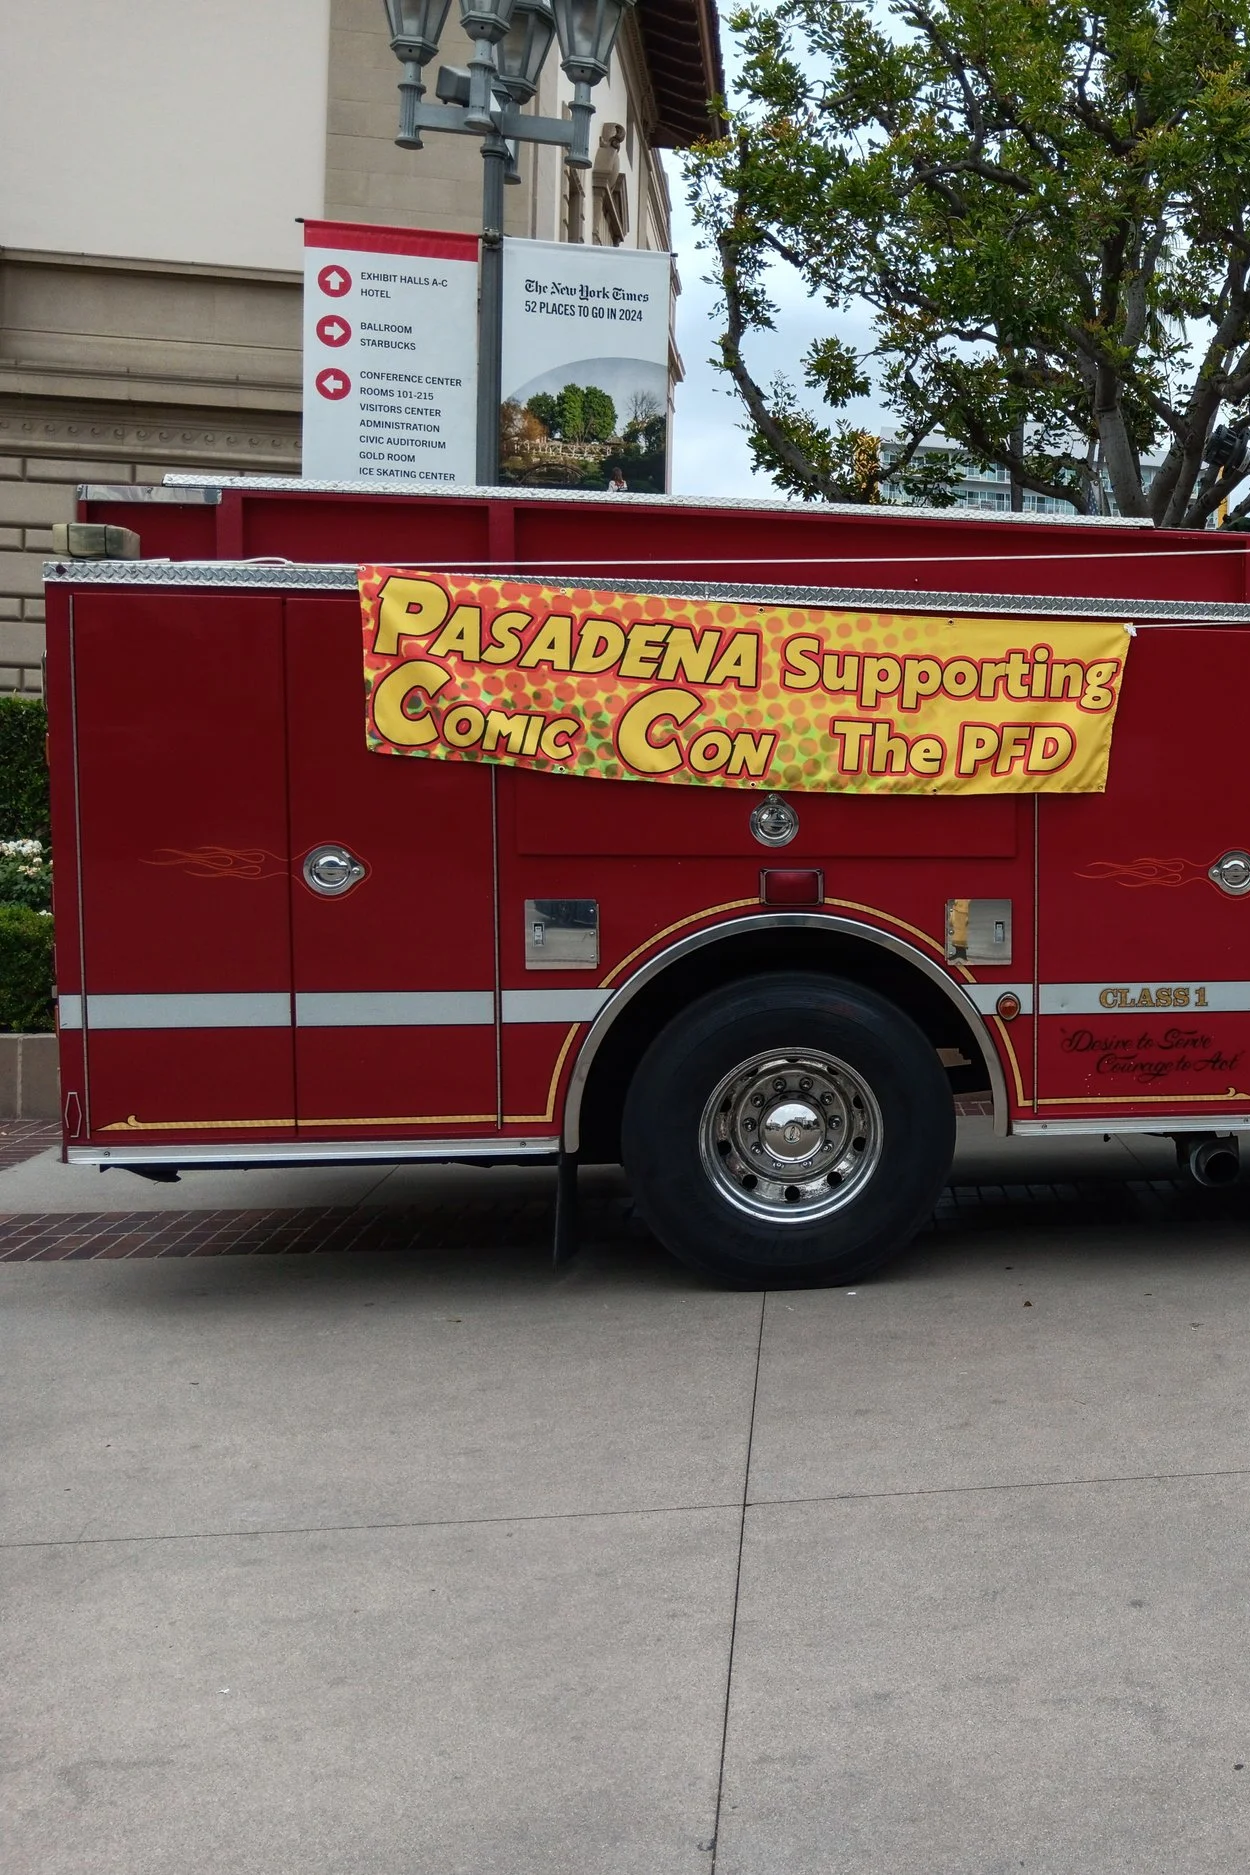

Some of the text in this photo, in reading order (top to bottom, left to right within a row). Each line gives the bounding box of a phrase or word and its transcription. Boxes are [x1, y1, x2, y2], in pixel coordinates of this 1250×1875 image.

[360, 271, 448, 288] EXHIBIT HALLS A-C
[360, 288, 392, 299] HOTEL
[524, 278, 649, 303] The New York Times
[524, 300, 643, 322] 52 PLACES TO GO IN 2024
[360, 321, 413, 334] BALLROOM
[360, 337, 417, 351] STARBUCKS
[359, 370, 462, 387] CONFERENCE CENTER
[359, 386, 434, 401] ROOMS 101-215
[359, 402, 442, 417] VISITORS CENTER
[359, 419, 440, 433] ADMINISTRATION
[359, 434, 446, 449] CIVIC AUDITORIUM
[358, 450, 416, 463] GOLD ROOM
[359, 466, 456, 481] ICE SKATING CENTER
[372, 574, 759, 688] PASADENA
[782, 635, 1118, 711] Supporting
[372, 659, 776, 777] COMIC CON
[832, 719, 1075, 777] The PFD
[1099, 986, 1209, 1009] CLASS 1
[1136, 1032, 1153, 1050] to
[1157, 1028, 1211, 1050] Serve
[1096, 1053, 1173, 1083] Courage
[1175, 1055, 1191, 1071] to
